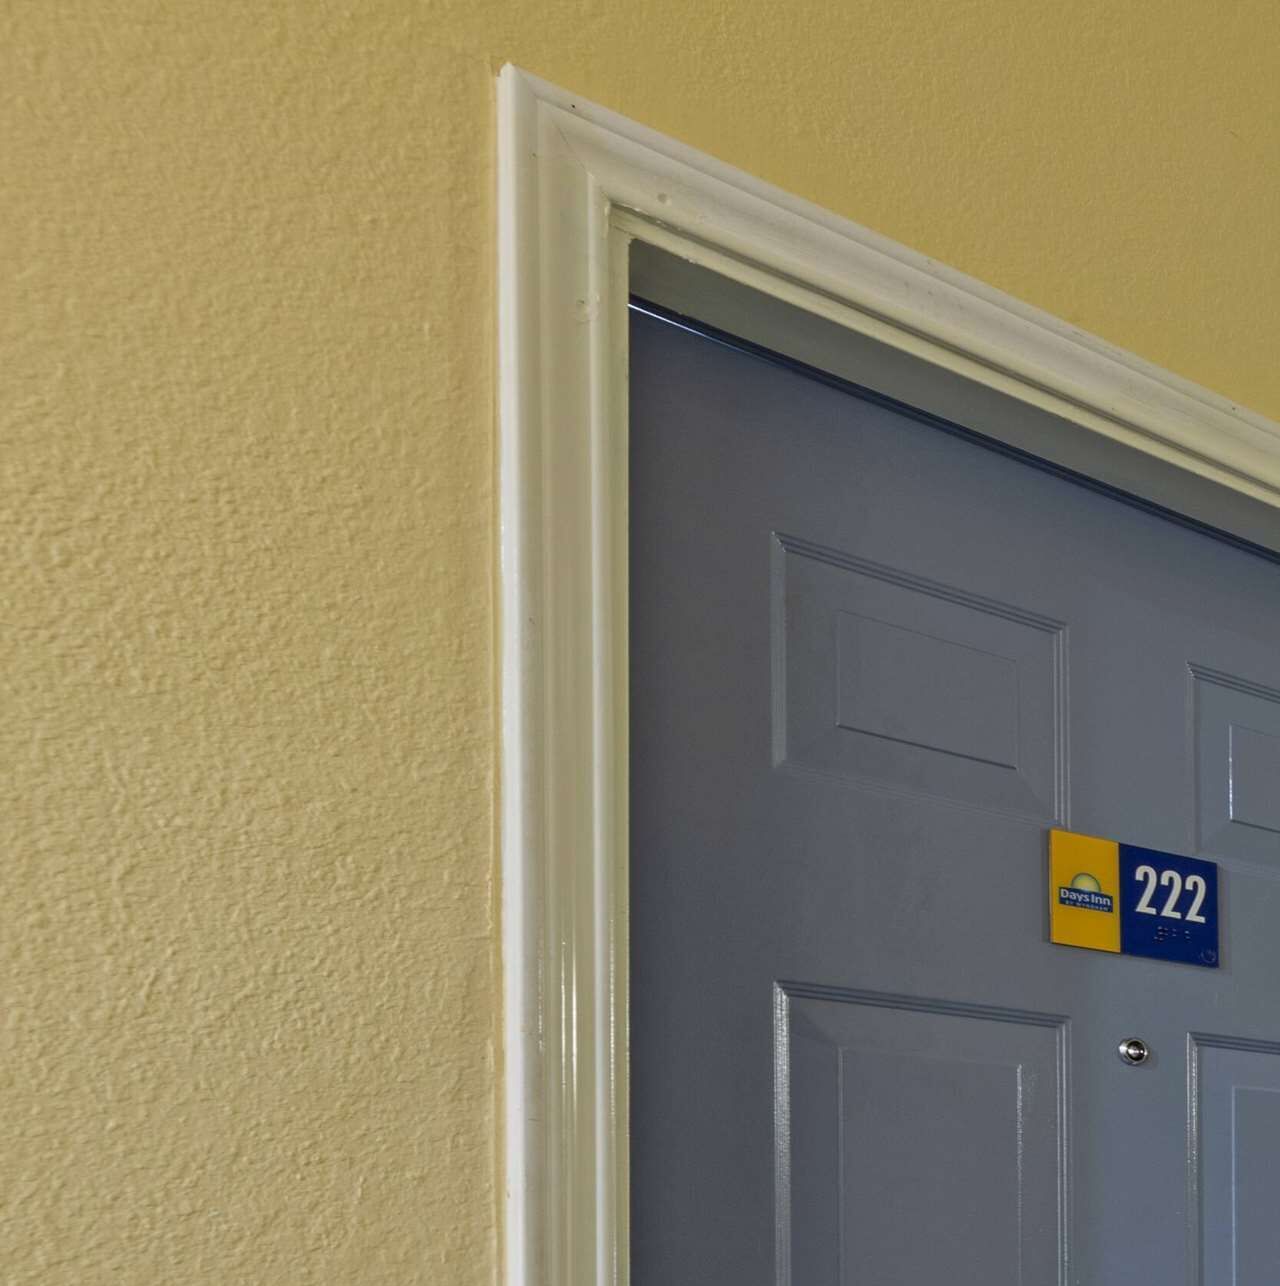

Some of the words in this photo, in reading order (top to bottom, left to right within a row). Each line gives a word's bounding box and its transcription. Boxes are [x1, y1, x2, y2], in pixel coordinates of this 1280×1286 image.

[1060, 888, 1090, 903] Days
[1091, 893, 1111, 906] Inn
[1135, 865, 1206, 924] 222
